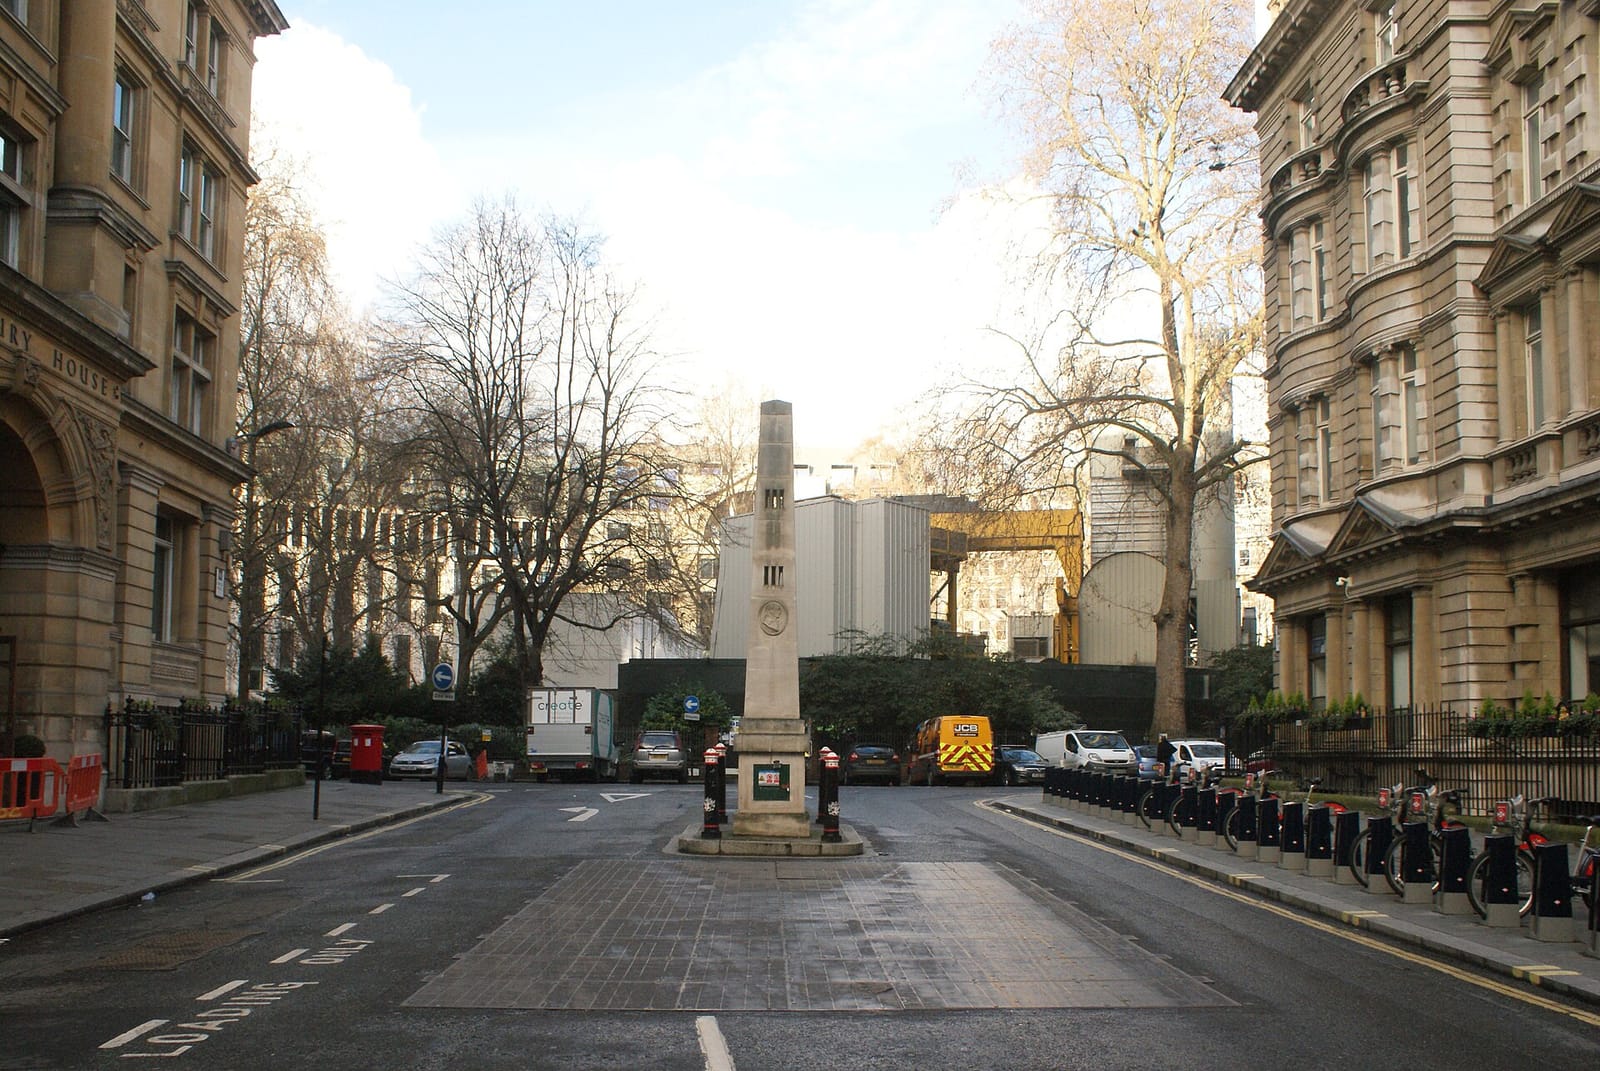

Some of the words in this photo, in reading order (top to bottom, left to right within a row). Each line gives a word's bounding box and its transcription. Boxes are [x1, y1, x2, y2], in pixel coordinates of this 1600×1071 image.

[53, 348, 109, 396] HOUSE
[537, 700, 582, 711] create
[954, 724, 978, 732] JCB
[120, 981, 320, 1058] LOADING
[300, 938, 375, 965] ONLY
